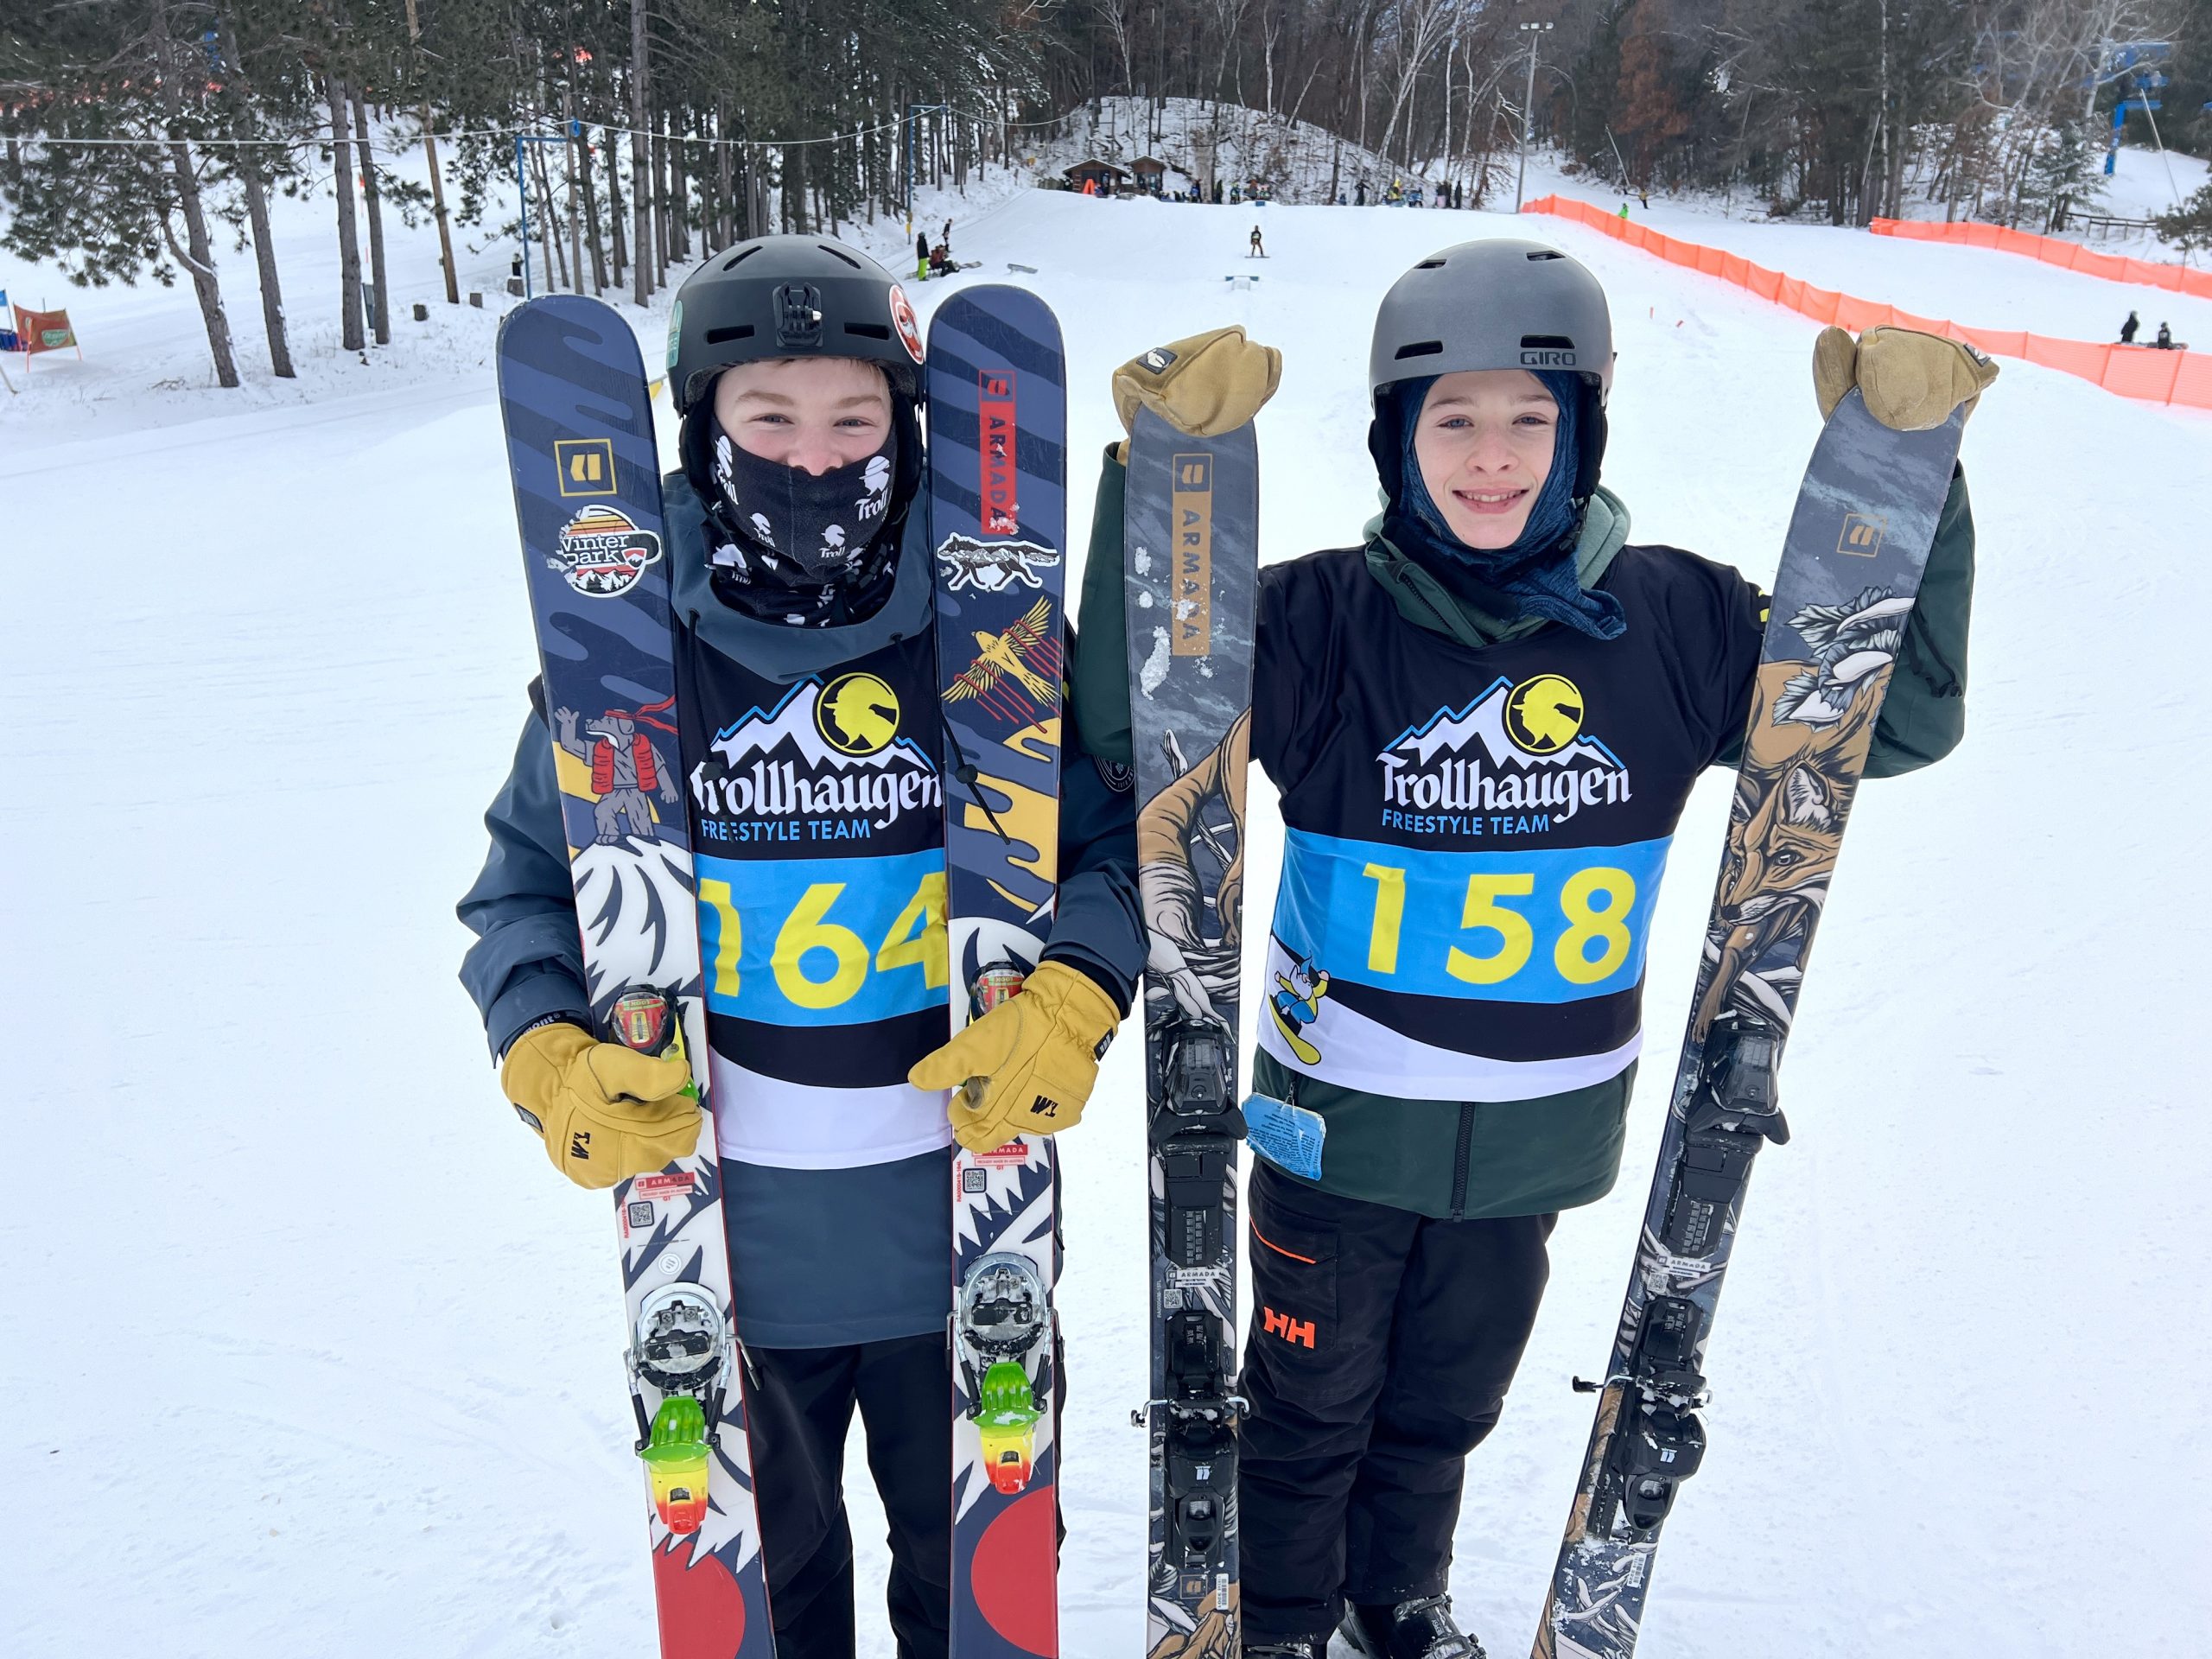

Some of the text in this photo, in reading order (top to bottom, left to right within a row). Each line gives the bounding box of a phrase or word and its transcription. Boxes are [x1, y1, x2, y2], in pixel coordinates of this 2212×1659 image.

[1521, 352, 1576, 366] GIRO
[988, 416, 1008, 524] ARMADA
[854, 488, 889, 522] Troll
[818, 545, 846, 559] Troll
[1376, 751, 1633, 823] Trollhaugen
[807, 818, 871, 840] TEAM
[1382, 809, 1550, 836] FREESTYLE TEAM
[1362, 861, 1637, 985] 158
[698, 870, 949, 1010] 164
[651, 1175, 690, 1186] ARMADA
[1670, 1259, 1707, 1269] ARMADA
[1263, 1306, 1316, 1350] HH
